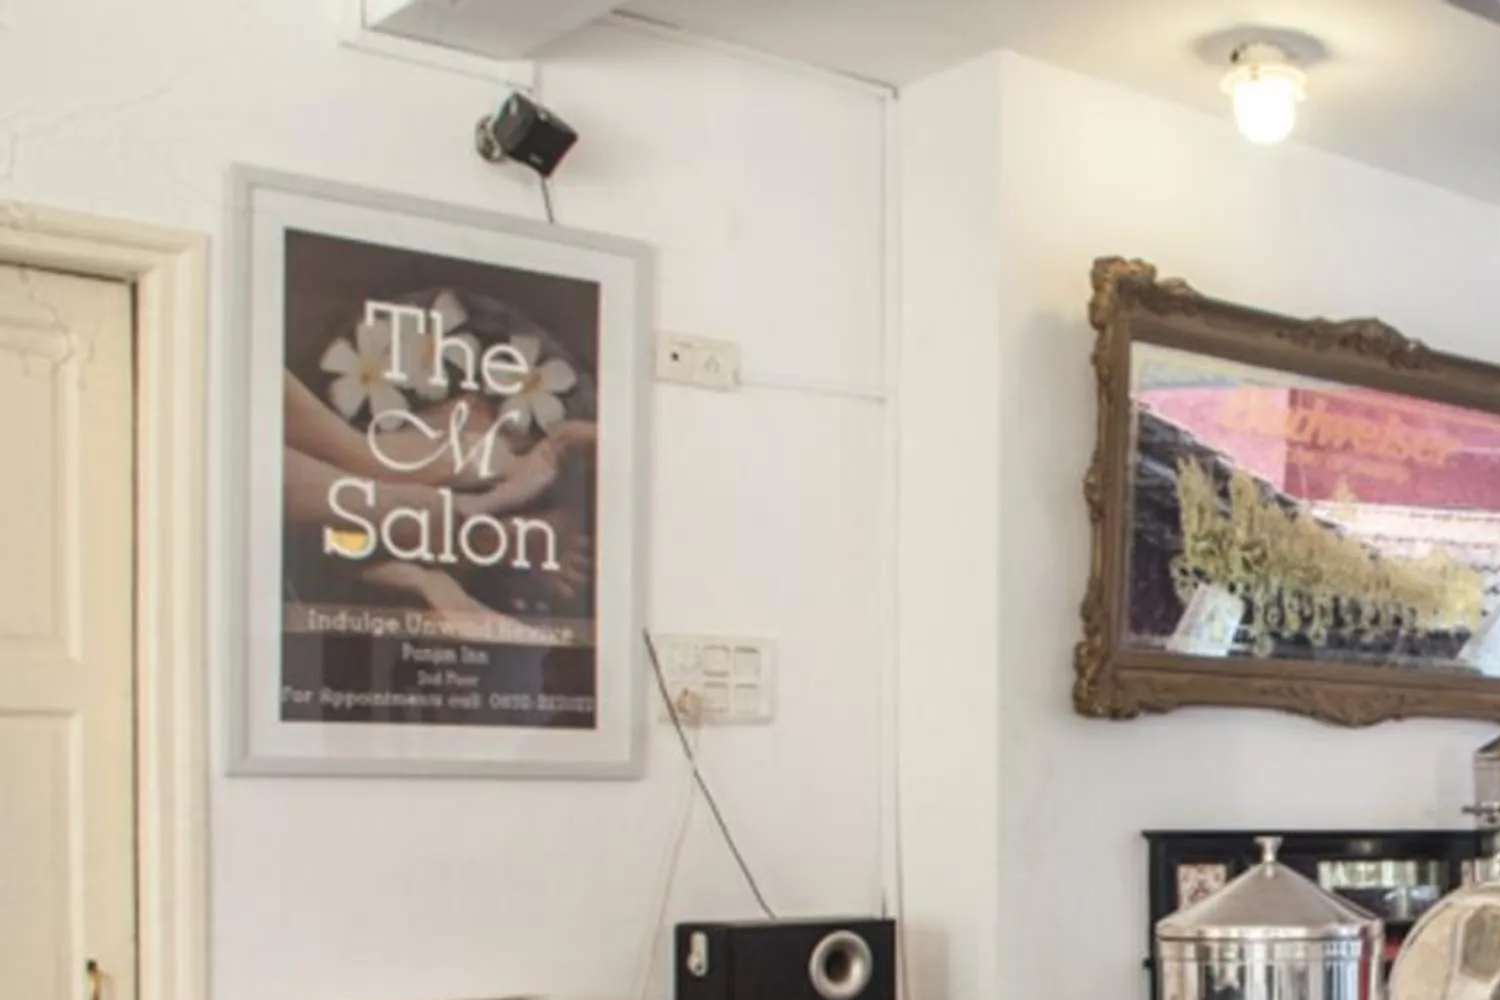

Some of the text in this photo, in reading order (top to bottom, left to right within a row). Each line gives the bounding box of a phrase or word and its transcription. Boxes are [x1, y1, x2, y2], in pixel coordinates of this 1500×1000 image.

[365, 300, 529, 394] The
[322, 477, 560, 571] Salon
[307, 608, 400, 637] Indulge
